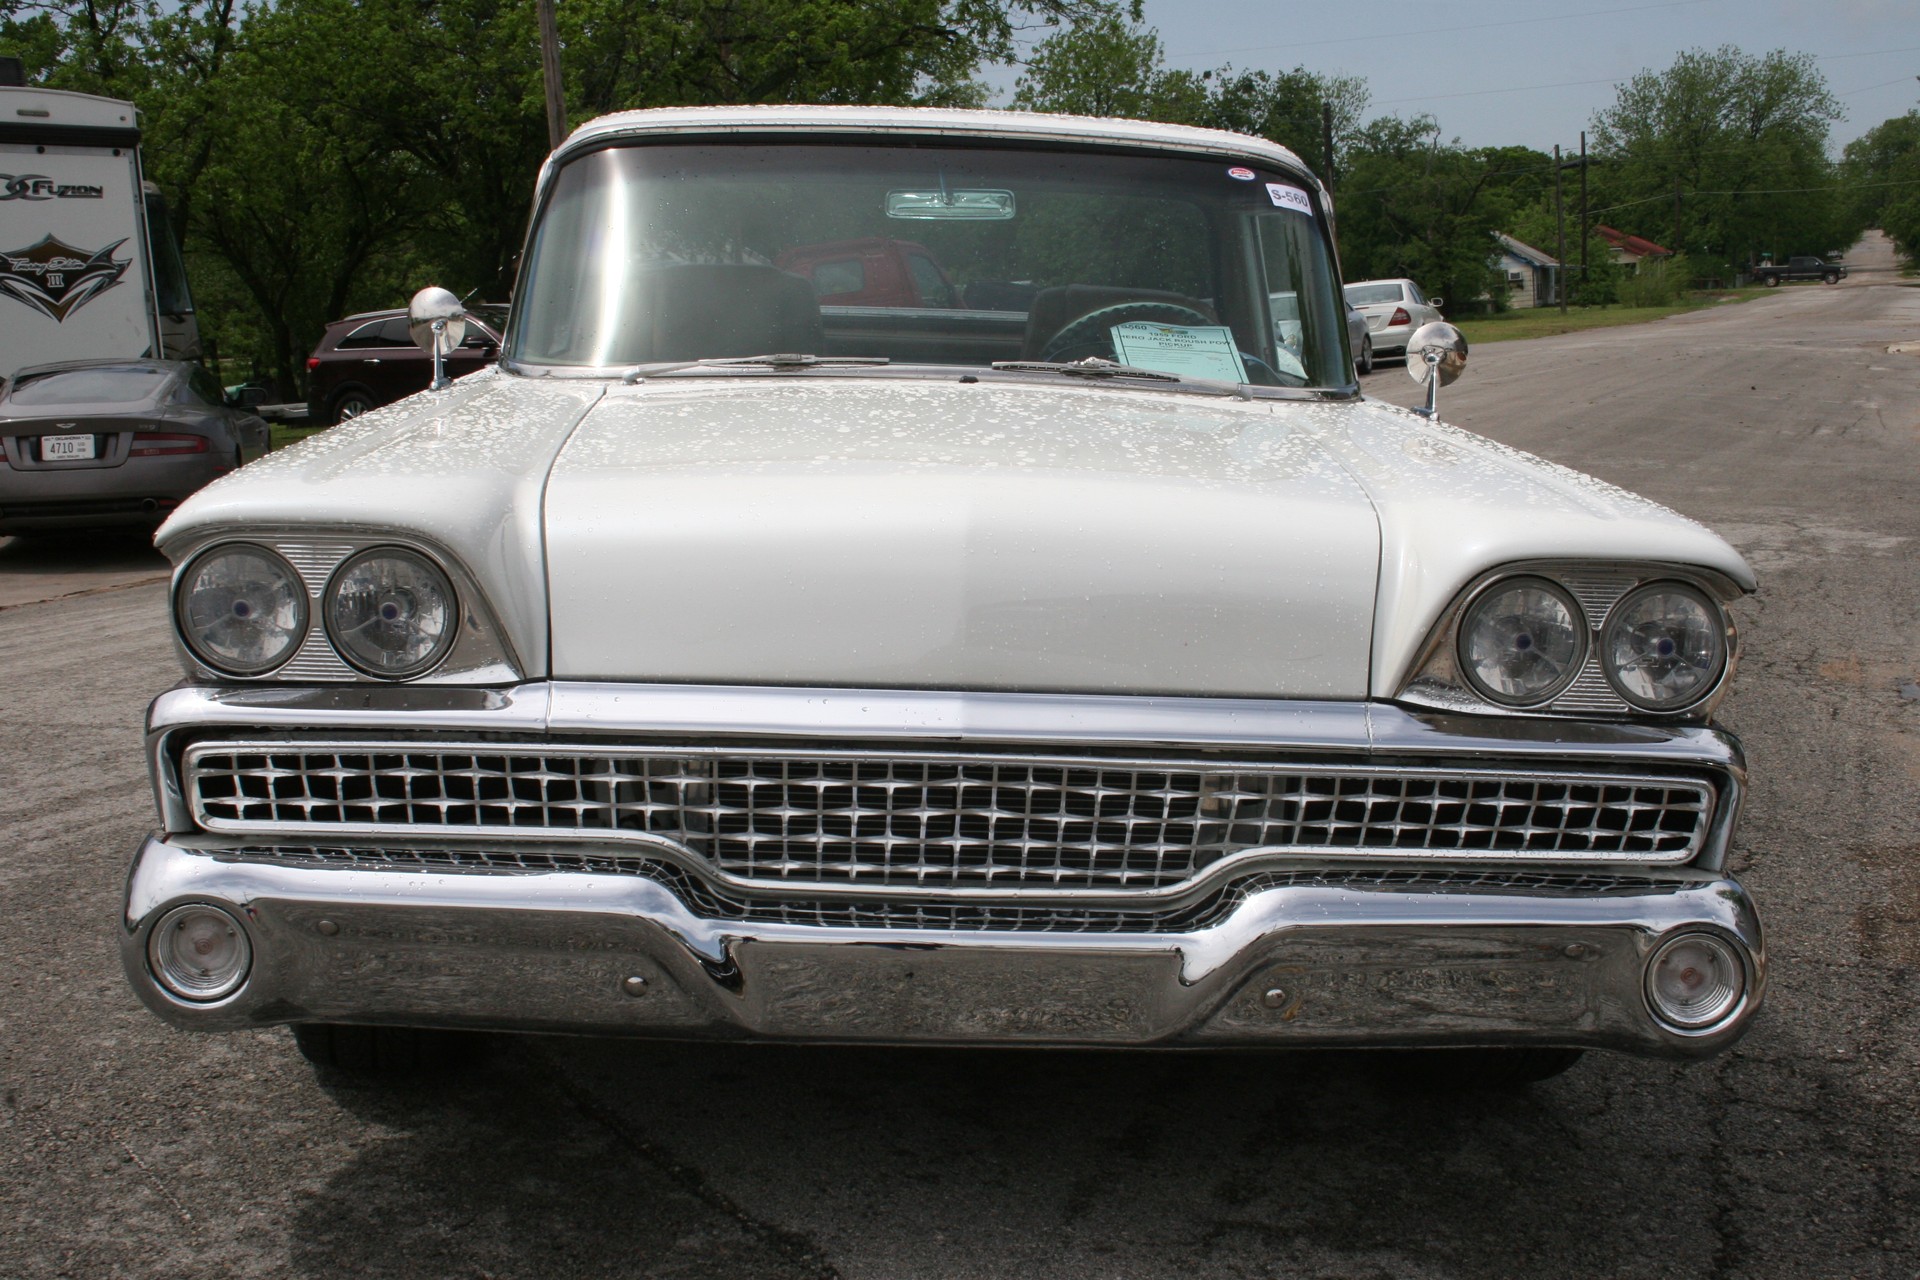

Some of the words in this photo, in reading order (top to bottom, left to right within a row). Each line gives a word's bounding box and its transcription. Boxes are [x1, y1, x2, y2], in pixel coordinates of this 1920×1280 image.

[1271, 189, 1308, 207] S-560
[9, 258, 47, 275] Touring
[47, 257, 87, 270] Edition
[47, 273, 64, 287] III
[50, 442, 74, 454] 4710
